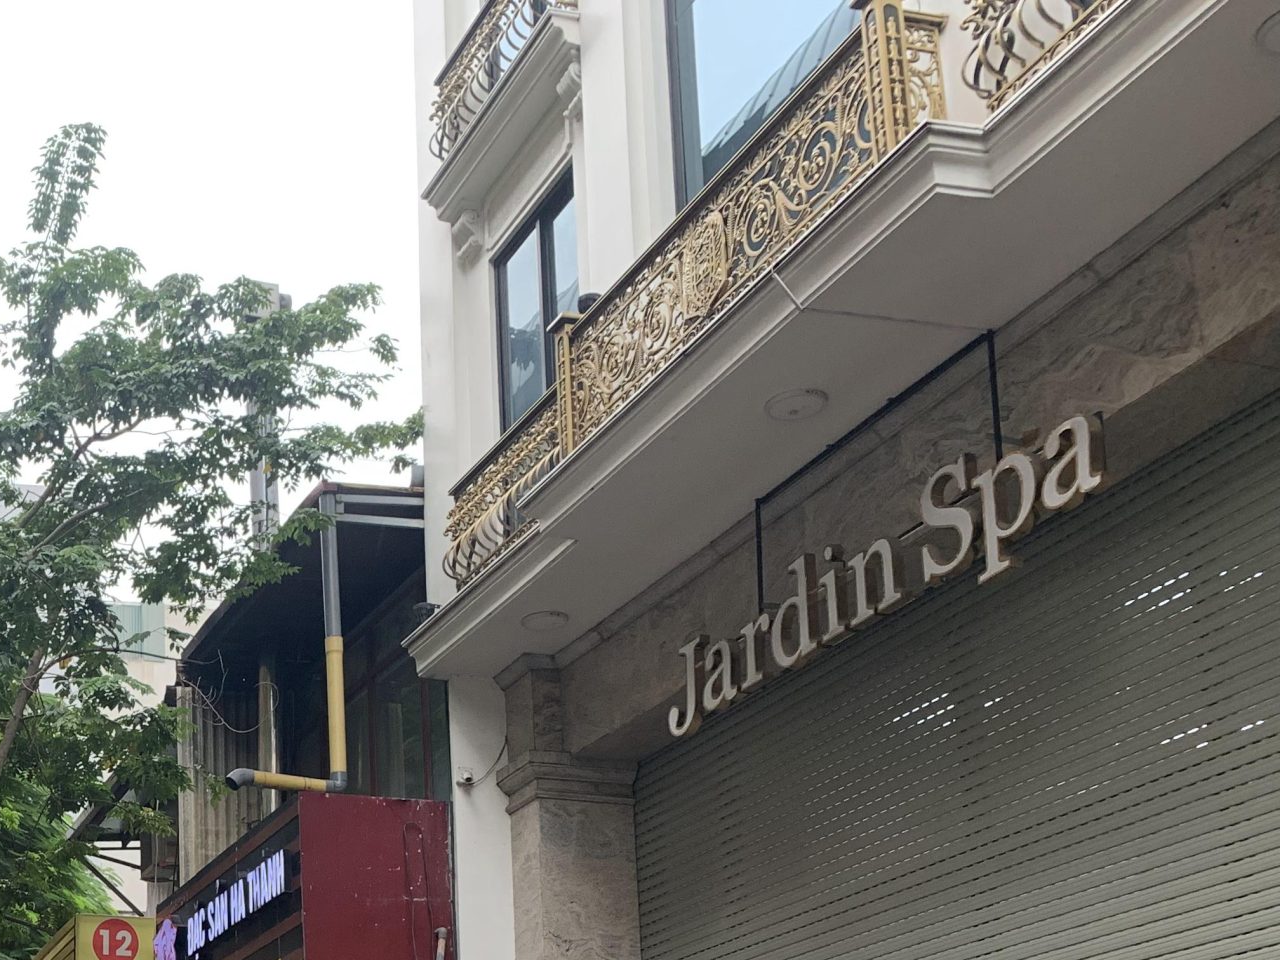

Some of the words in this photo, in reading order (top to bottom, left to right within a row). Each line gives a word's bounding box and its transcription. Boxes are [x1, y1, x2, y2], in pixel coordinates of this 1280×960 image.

[668, 538, 902, 737] Jardin
[921, 414, 1104, 584] Spa
[207, 879, 228, 942] SẢN
[99, 929, 133, 957] 12
